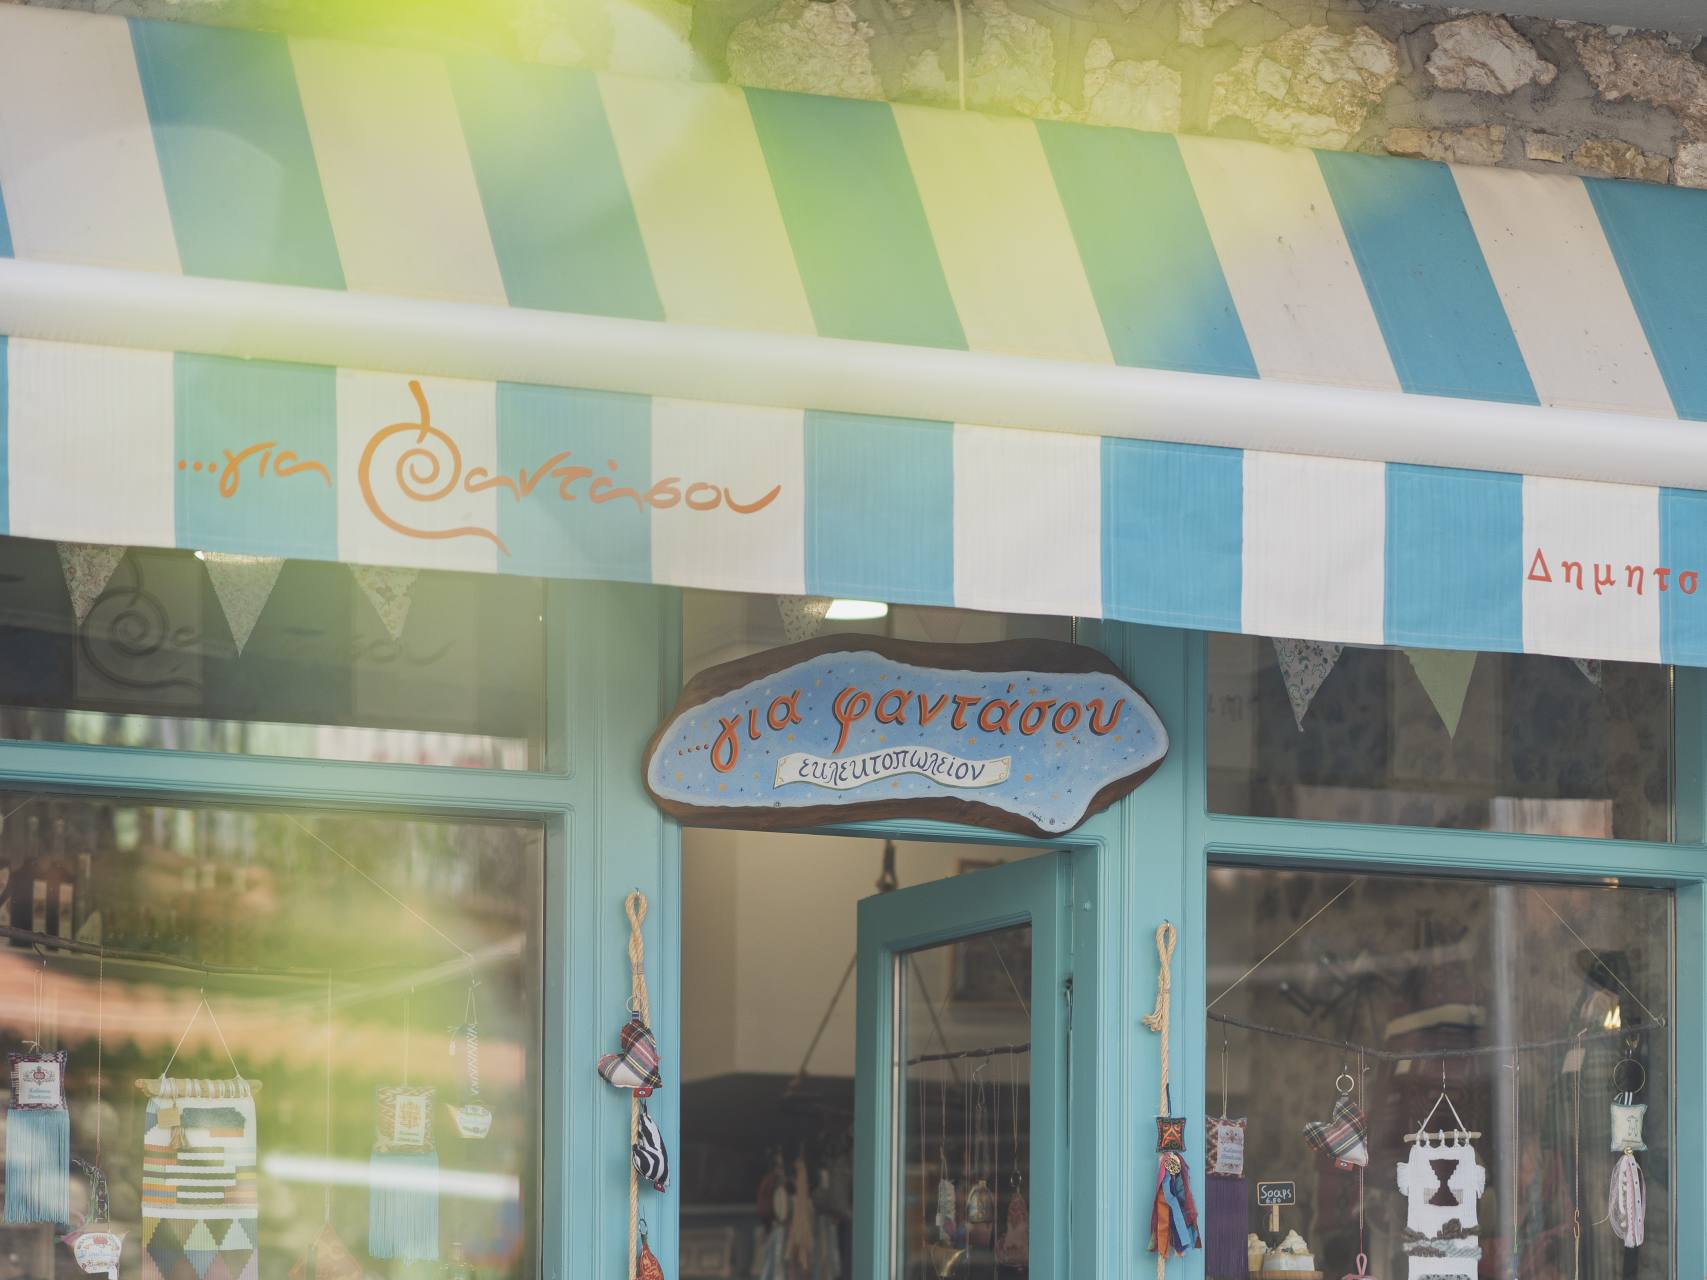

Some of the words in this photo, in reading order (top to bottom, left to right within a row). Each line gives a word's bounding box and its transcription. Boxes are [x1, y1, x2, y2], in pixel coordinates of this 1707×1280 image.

[1527, 546, 1699, 596] Δημητσ
[831, 682, 1126, 755] φαντάσου
[1260, 1184, 1292, 1200] Soaps
